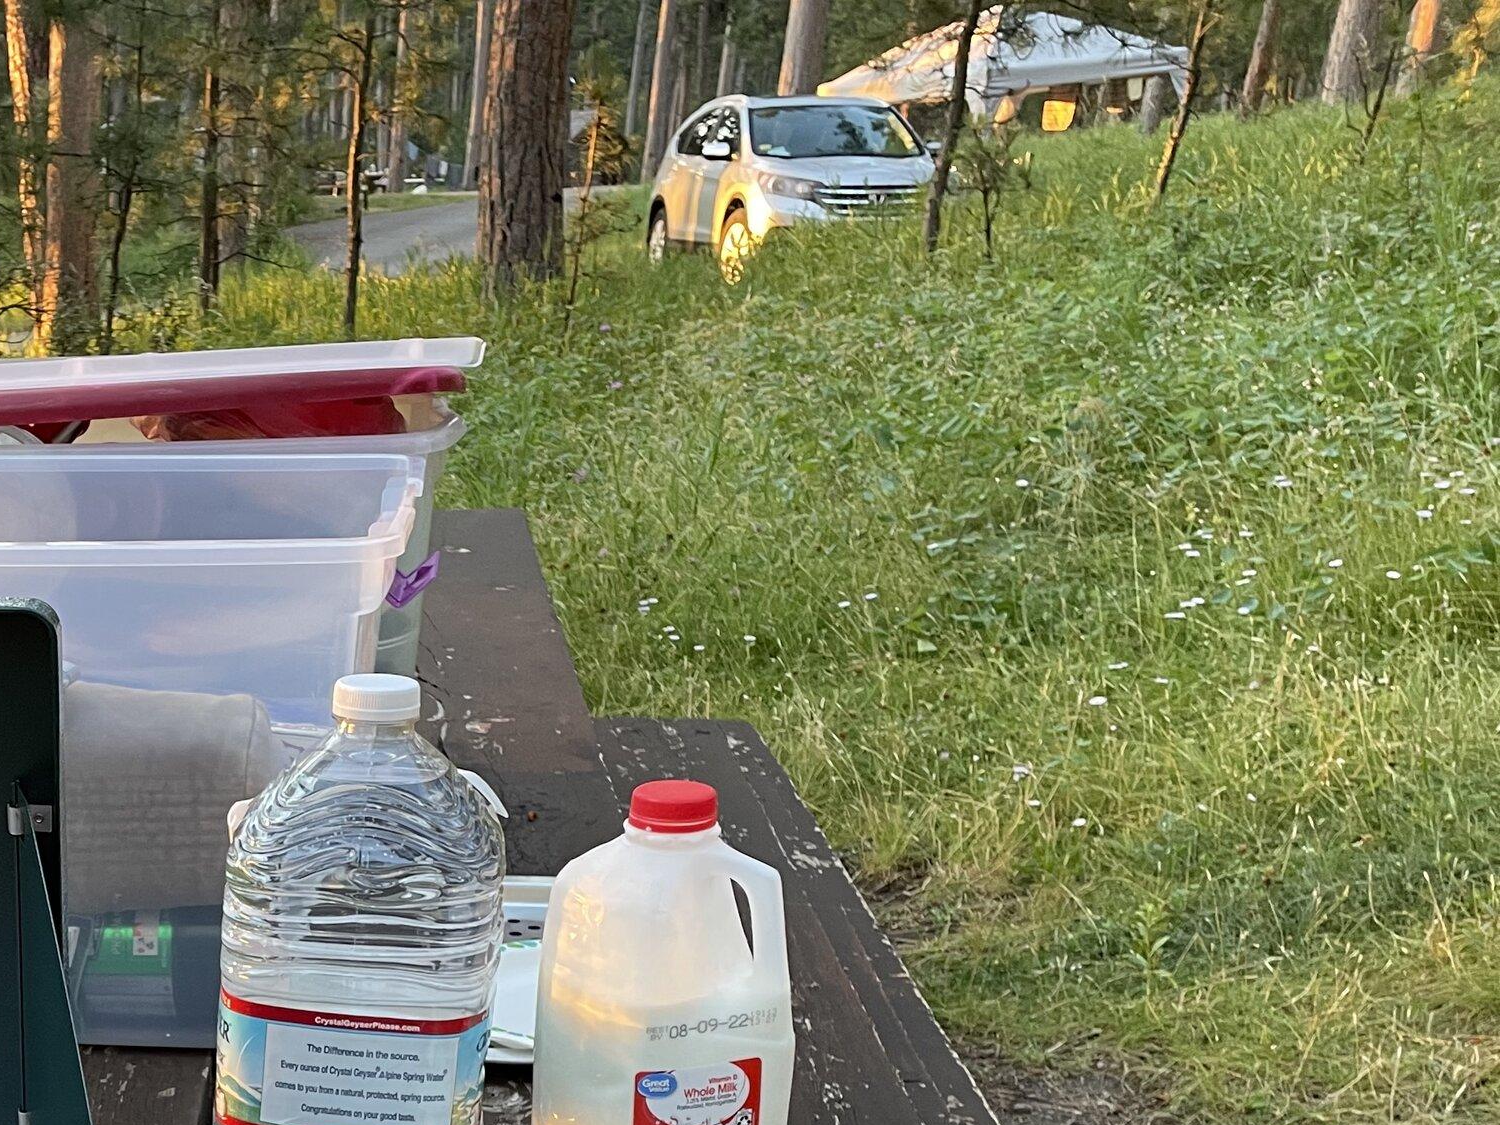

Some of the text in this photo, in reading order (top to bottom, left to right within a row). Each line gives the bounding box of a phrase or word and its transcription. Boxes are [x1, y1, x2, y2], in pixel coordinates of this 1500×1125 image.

[314, 1015, 421, 1033] CrystalGeyserPlease.com
[669, 1013, 749, 1039] 08-09-22
[307, 1044, 420, 1062] The Difference in the source.
[281, 1060, 299, 1071] Every
[300, 1064, 319, 1072] ounce
[330, 1066, 352, 1076] Crystal
[403, 1072, 424, 1083] Spring
[275, 1081, 296, 1089] comes
[319, 1086, 333, 1094] from
[341, 1089, 365, 1098] natural,
[366, 1091, 399, 1101] protected,
[401, 1094, 421, 1103] spring
[642, 1079, 670, 1087] Great
[684, 1087, 715, 1098] Whole
[718, 1083, 738, 1093] Milk
[301, 1103, 352, 1117] Congratulations
[363, 1111, 378, 1120] your
[380, 1113, 397, 1122] good
